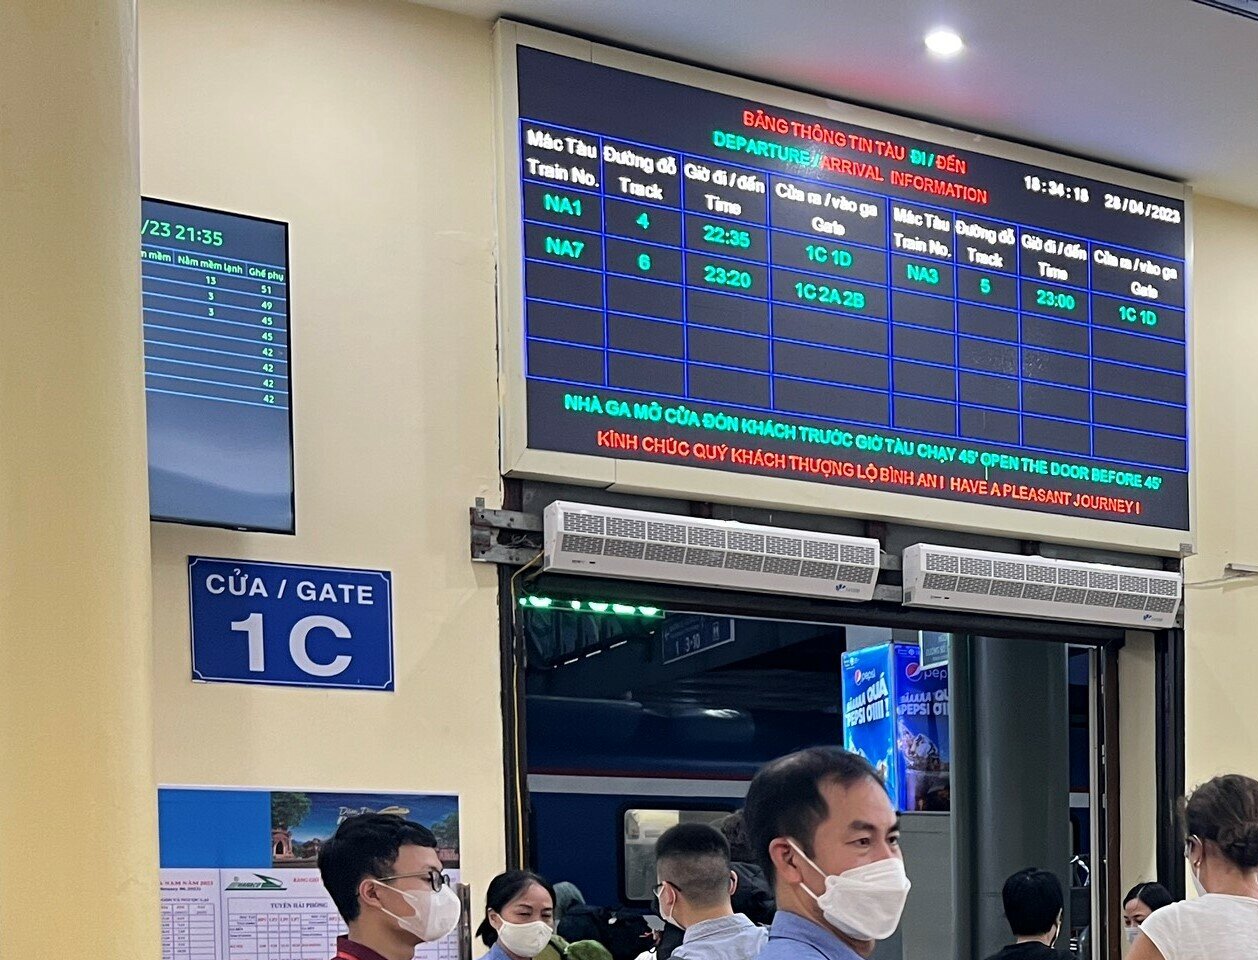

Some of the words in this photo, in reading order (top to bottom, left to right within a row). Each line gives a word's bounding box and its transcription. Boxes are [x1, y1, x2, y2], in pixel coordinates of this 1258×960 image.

[526, 128, 564, 152] Mác
[564, 137, 598, 159] Tàu
[743, 109, 789, 135] BẢNG
[790, 121, 847, 148] THÔNG
[848, 133, 875, 153] TIN
[875, 140, 906, 161] TÀU
[909, 148, 927, 167] ĐI
[935, 153, 967, 175] ĐẾN
[603, 145, 654, 175] Đường
[656, 155, 677, 175] đỗ
[712, 130, 810, 167] DEPARTURE
[820, 155, 884, 182] ARRIVAL
[890, 171, 988, 204] INFORMATION
[526, 157, 569, 181] Train
[571, 166, 600, 188] No.
[684, 162, 710, 182] Giờ
[712, 169, 728, 187] đi
[737, 174, 766, 194] đến
[618, 176, 664, 201] Track
[543, 193, 582, 217] NA1
[704, 193, 742, 216] Time
[775, 182, 805, 203] Cửa
[807, 192, 822, 206] ra
[832, 196, 858, 212] vào
[859, 203, 878, 218] ga
[635, 212, 650, 230] 4
[811, 216, 846, 236] Gate
[893, 206, 923, 227] Mác
[923, 212, 950, 232] Tàu
[175, 225, 224, 247] 21:35
[703, 224, 751, 249] 22:35
[955, 219, 997, 245] Đường
[998, 227, 1016, 245] đỗ
[1021, 234, 1042, 251] Giờ
[148, 249, 172, 262] mềm
[544, 235, 585, 259] NA7
[893, 232, 927, 253] Train
[928, 239, 953, 259] No.
[200, 258, 222, 271] mềm
[224, 262, 243, 275] lạnh
[636, 253, 651, 271] 6
[805, 245, 828, 263] 1C
[831, 249, 853, 268] 1D
[967, 246, 1004, 268] Track
[205, 275, 217, 286] 13
[249, 267, 266, 278] Ghế
[267, 272, 284, 283] phụ
[704, 264, 752, 289] 23:20
[907, 263, 939, 285] NA3
[1038, 261, 1069, 281] Time
[1162, 267, 1178, 281] ga
[208, 291, 215, 301] 3
[261, 285, 272, 295] 51
[795, 282, 816, 301] 1C
[818, 286, 842, 306] 2A
[842, 290, 865, 309] 2B
[980, 277, 991, 294] 5
[261, 301, 273, 311] 49
[1036, 289, 1076, 310] 23:00
[208, 308, 215, 317] 3
[261, 316, 273, 326] 45
[1119, 305, 1137, 322] 1C
[1139, 309, 1157, 326] 1D
[262, 332, 274, 342] 45
[262, 347, 274, 357] 42
[262, 363, 274, 373] 42
[263, 378, 274, 388] 42
[263, 394, 275, 404] 42
[564, 393, 603, 414] NHÀ
[605, 399, 632, 419] GA
[634, 401, 663, 423] MỞ
[664, 405, 701, 428] CỬA
[702, 411, 739, 433] ĐÓN
[742, 415, 796, 441] KHÁCH
[855, 434, 883, 452] GIỜ
[884, 437, 915, 457] TÀU
[917, 443, 957, 464] CHẠY
[958, 449, 979, 465] 45'
[980, 452, 1019, 471] OPEN
[1021, 457, 1049, 475] THE
[1050, 462, 1090, 481] DOOR
[1091, 467, 1143, 488] BEFORE
[1144, 475, 1162, 490] 45'
[597, 429, 638, 451] KÍNH
[641, 435, 690, 457] CHÚC
[693, 442, 728, 463] QUÝ
[730, 447, 786, 470] KHÁCH
[788, 454, 854, 478] THƯỢNG
[857, 463, 878, 483] LỘ
[880, 465, 915, 486] BÌNH
[950, 476, 988, 495] HAVE
[990, 481, 1001, 497] A
[1002, 483, 1072, 507] PLEASANT
[205, 568, 268, 597] CỬA
[277, 579, 287, 599] /
[296, 580, 374, 605] GATE
[924, 668, 948, 681] pep
